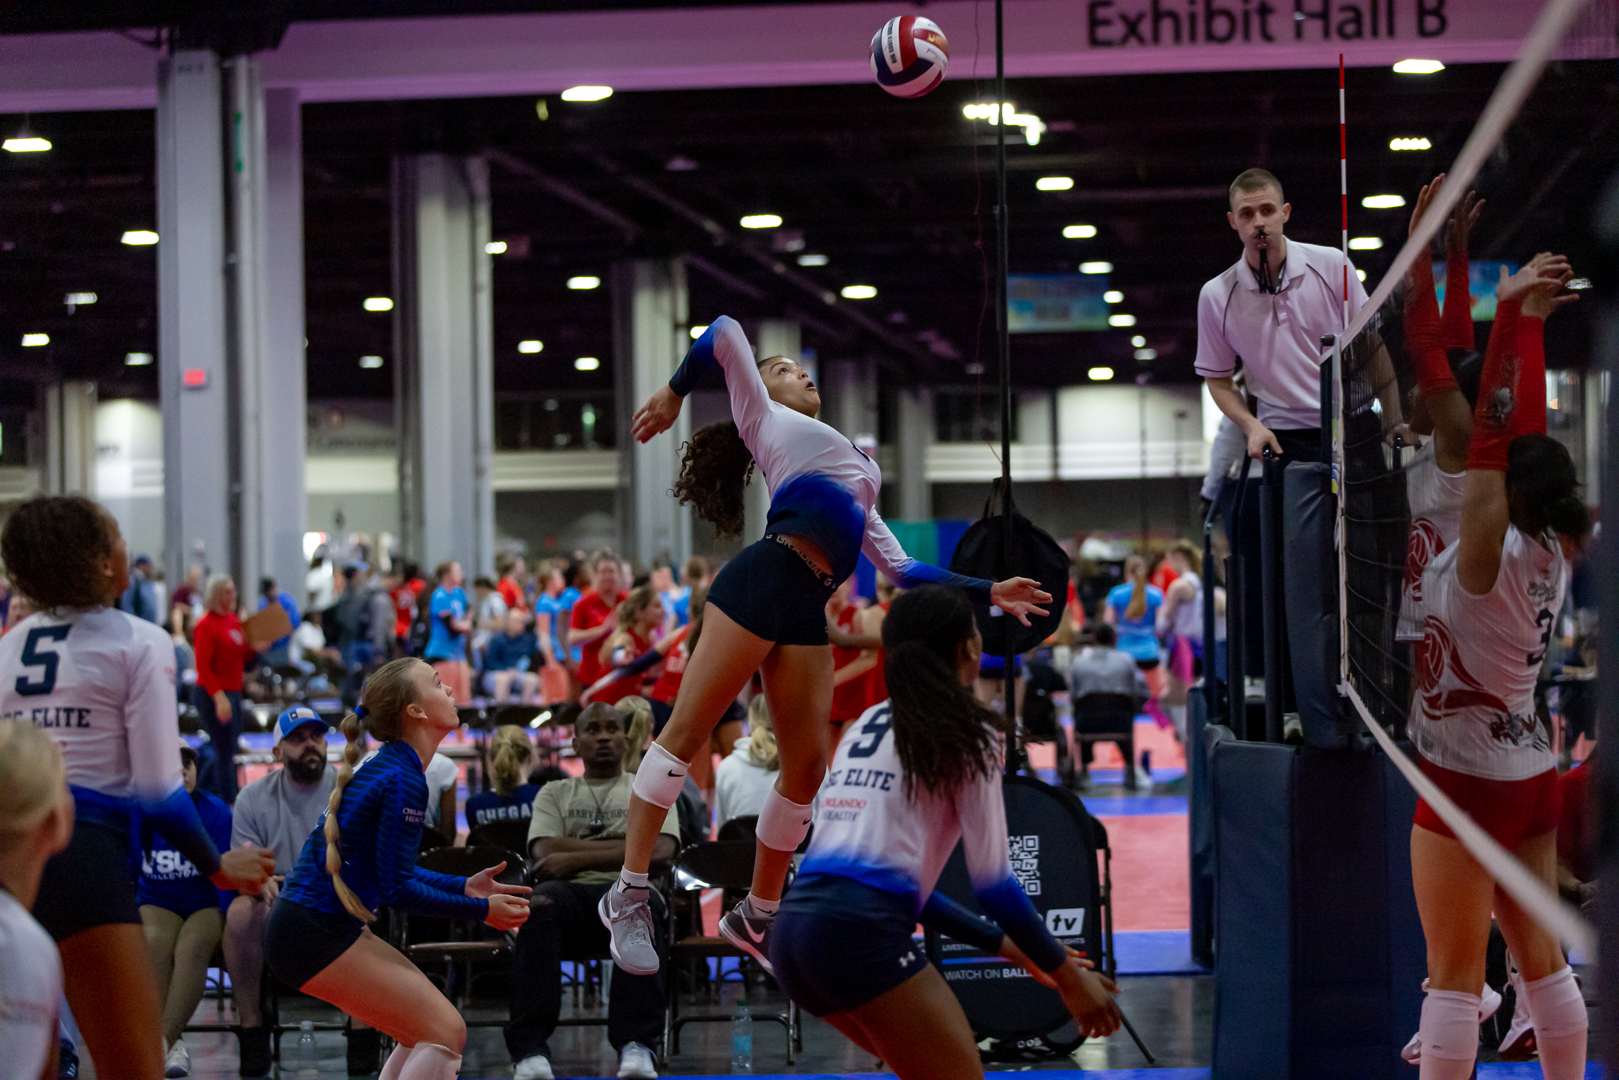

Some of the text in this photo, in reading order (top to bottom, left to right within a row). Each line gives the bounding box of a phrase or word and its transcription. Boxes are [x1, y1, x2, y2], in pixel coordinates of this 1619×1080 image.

[1088, 0, 1449, 47] Exhibit Hall B
[15, 624, 73, 697] 5
[31, 706, 91, 728] ELITE
[848, 706, 892, 758] 9
[843, 768, 896, 792] ELITE
[1052, 914, 1078, 932] tv
[944, 968, 1034, 980] WATCH ON BALL
